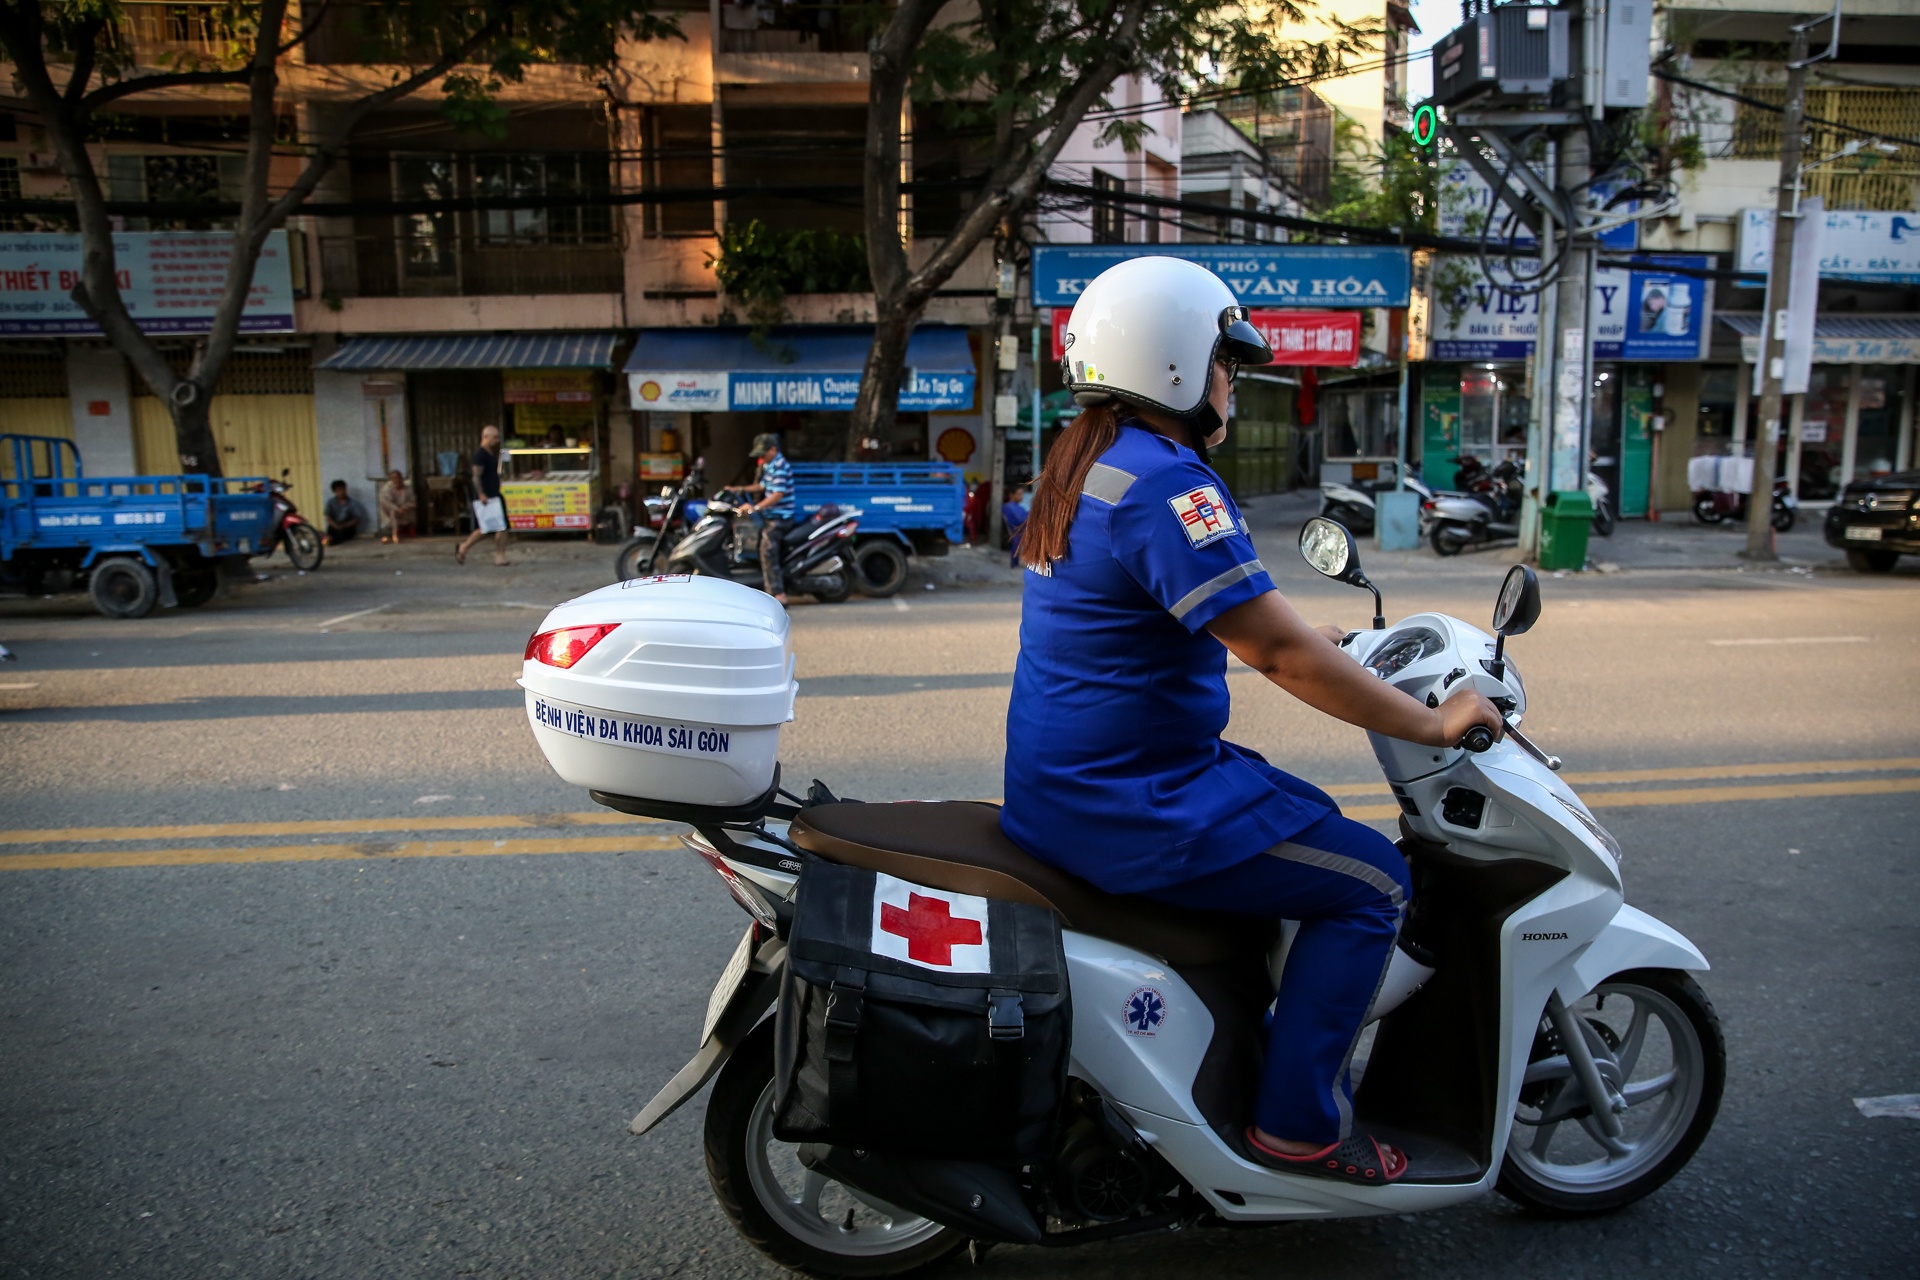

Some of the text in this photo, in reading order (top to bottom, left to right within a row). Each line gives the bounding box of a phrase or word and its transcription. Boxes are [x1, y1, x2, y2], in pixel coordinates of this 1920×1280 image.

[1218, 259, 1260, 273] PHỐ
[1265, 261, 1278, 273] 4
[1228, 275, 1300, 295] VĂN
[1311, 275, 1388, 295] HÓA
[734, 381, 773, 406] MINH
[932, 379, 948, 397] Tay
[949, 378, 964, 393] Ga
[535, 699, 729, 752] BỆNH VIỆN ĐA KHOA SÀI GÒN
[1522, 932, 1568, 941] HONDA
